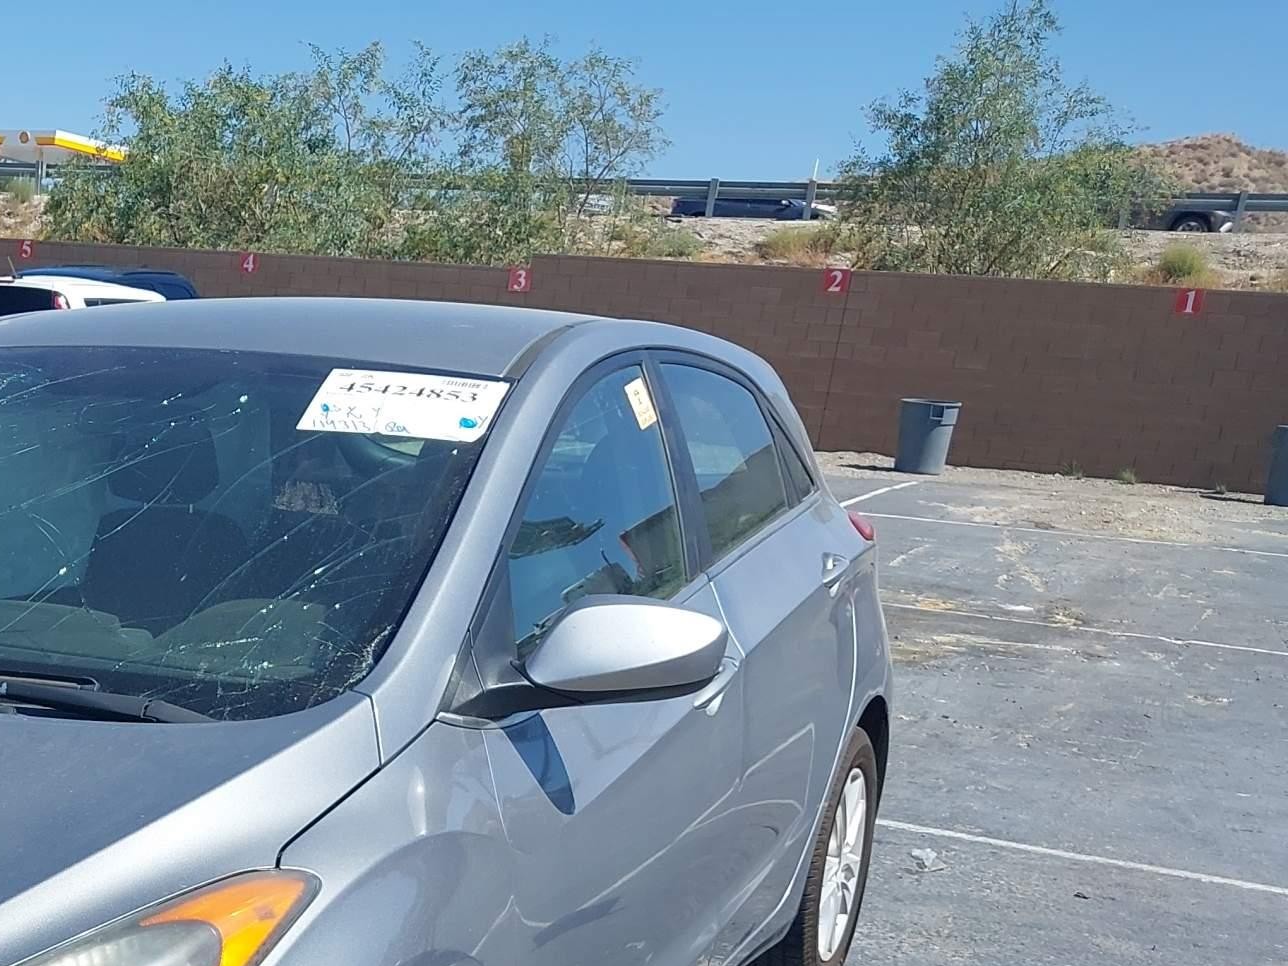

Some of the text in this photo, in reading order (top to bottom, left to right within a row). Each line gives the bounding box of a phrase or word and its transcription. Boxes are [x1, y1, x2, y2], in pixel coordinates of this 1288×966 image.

[21, 240, 32, 258] 5
[243, 253, 254, 272] 4
[513, 270, 526, 291] 3
[827, 270, 842, 292] 2
[1183, 290, 1196, 313] 1
[338, 381, 479, 403] 45424853
